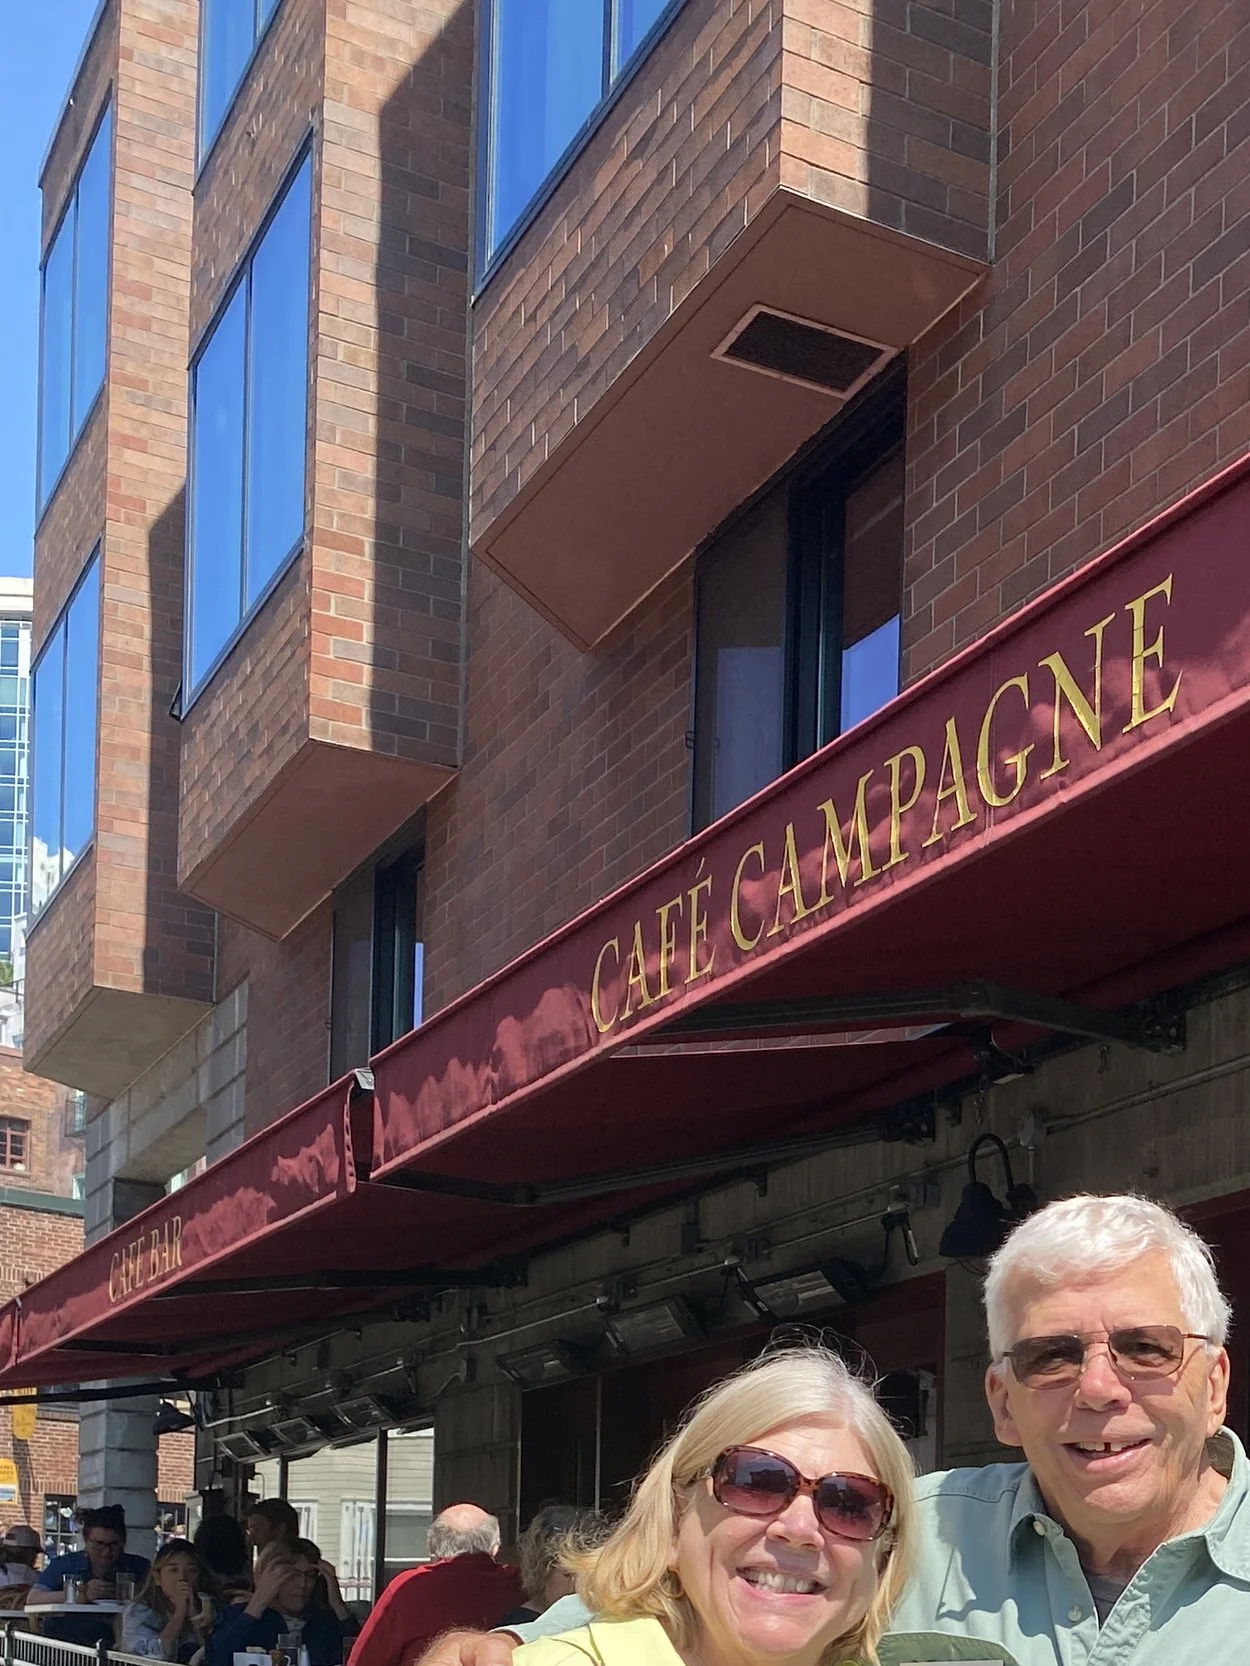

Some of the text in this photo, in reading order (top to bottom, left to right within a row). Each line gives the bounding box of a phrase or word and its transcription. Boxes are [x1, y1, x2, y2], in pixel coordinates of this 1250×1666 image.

[591, 573, 1184, 1033] CAFÉ CAMPAGNE
[109, 1215, 183, 1302] CAFÉ BAR
